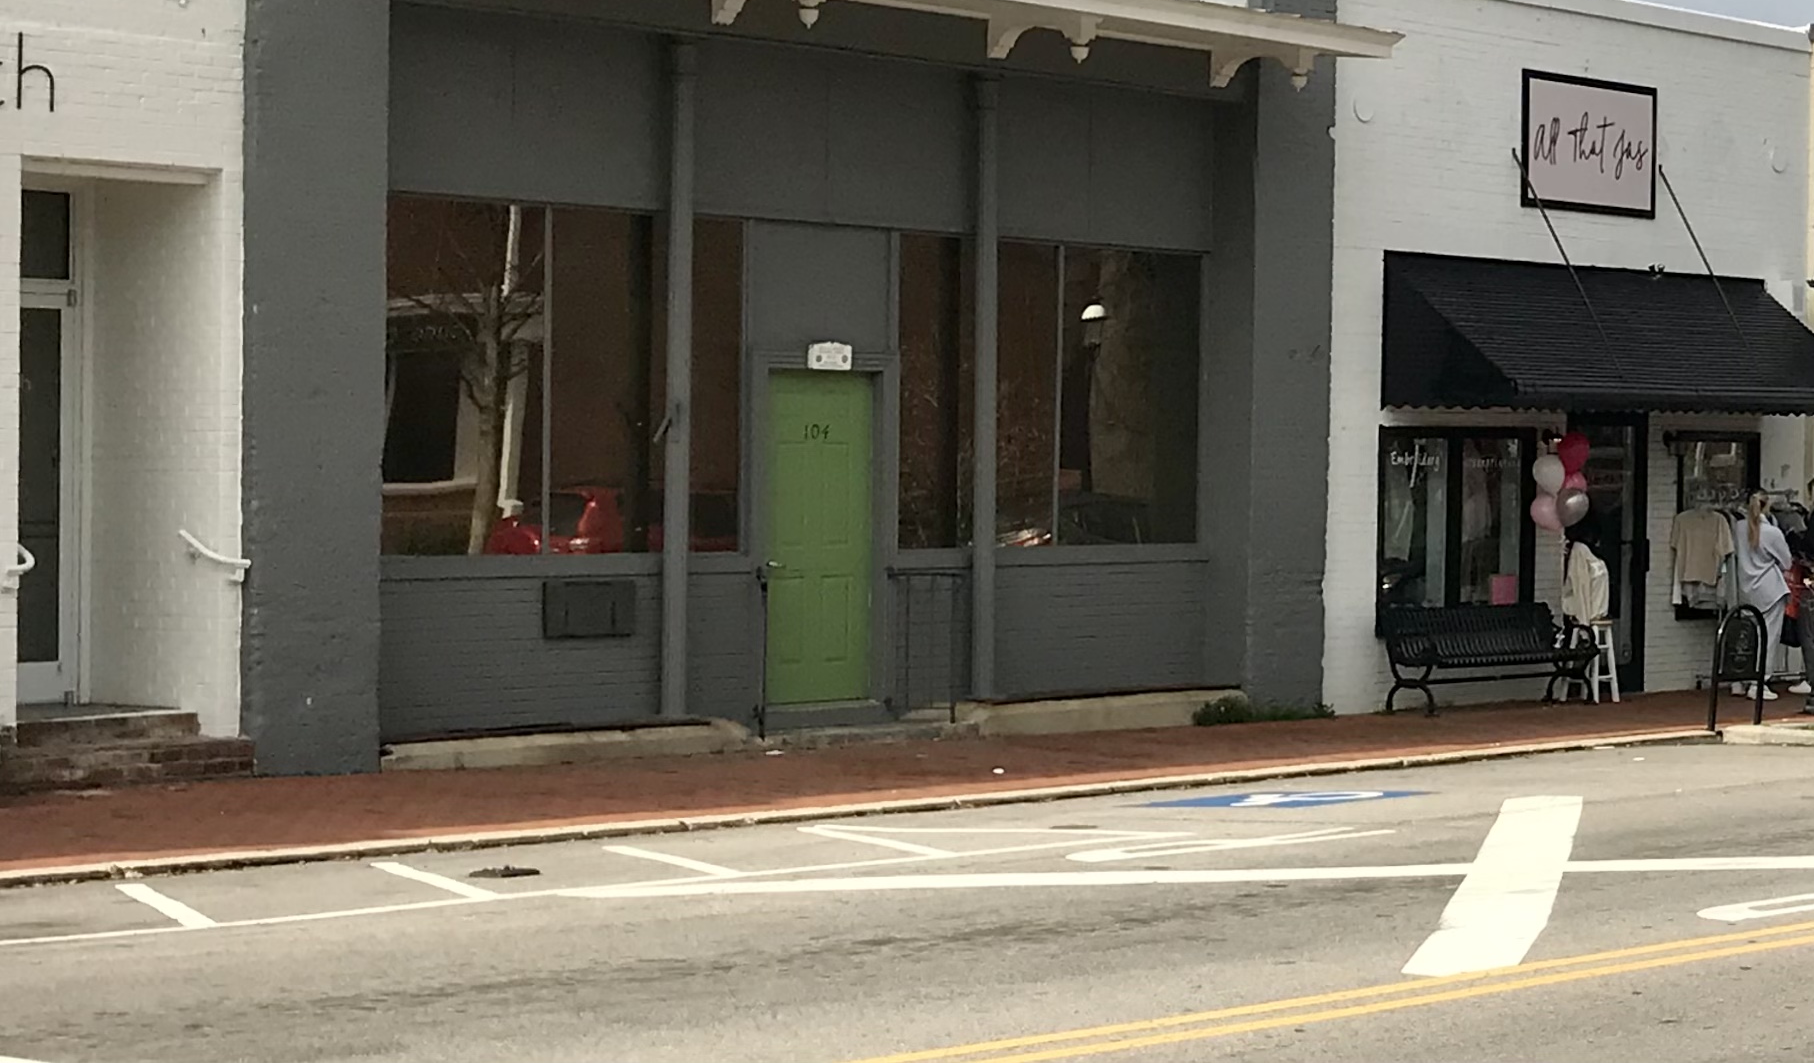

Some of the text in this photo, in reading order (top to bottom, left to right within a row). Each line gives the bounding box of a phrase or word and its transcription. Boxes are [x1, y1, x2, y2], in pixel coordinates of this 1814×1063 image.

[0, 31, 55, 112] h
[1567, 111, 1616, 174] That
[804, 424, 830, 440] 104
